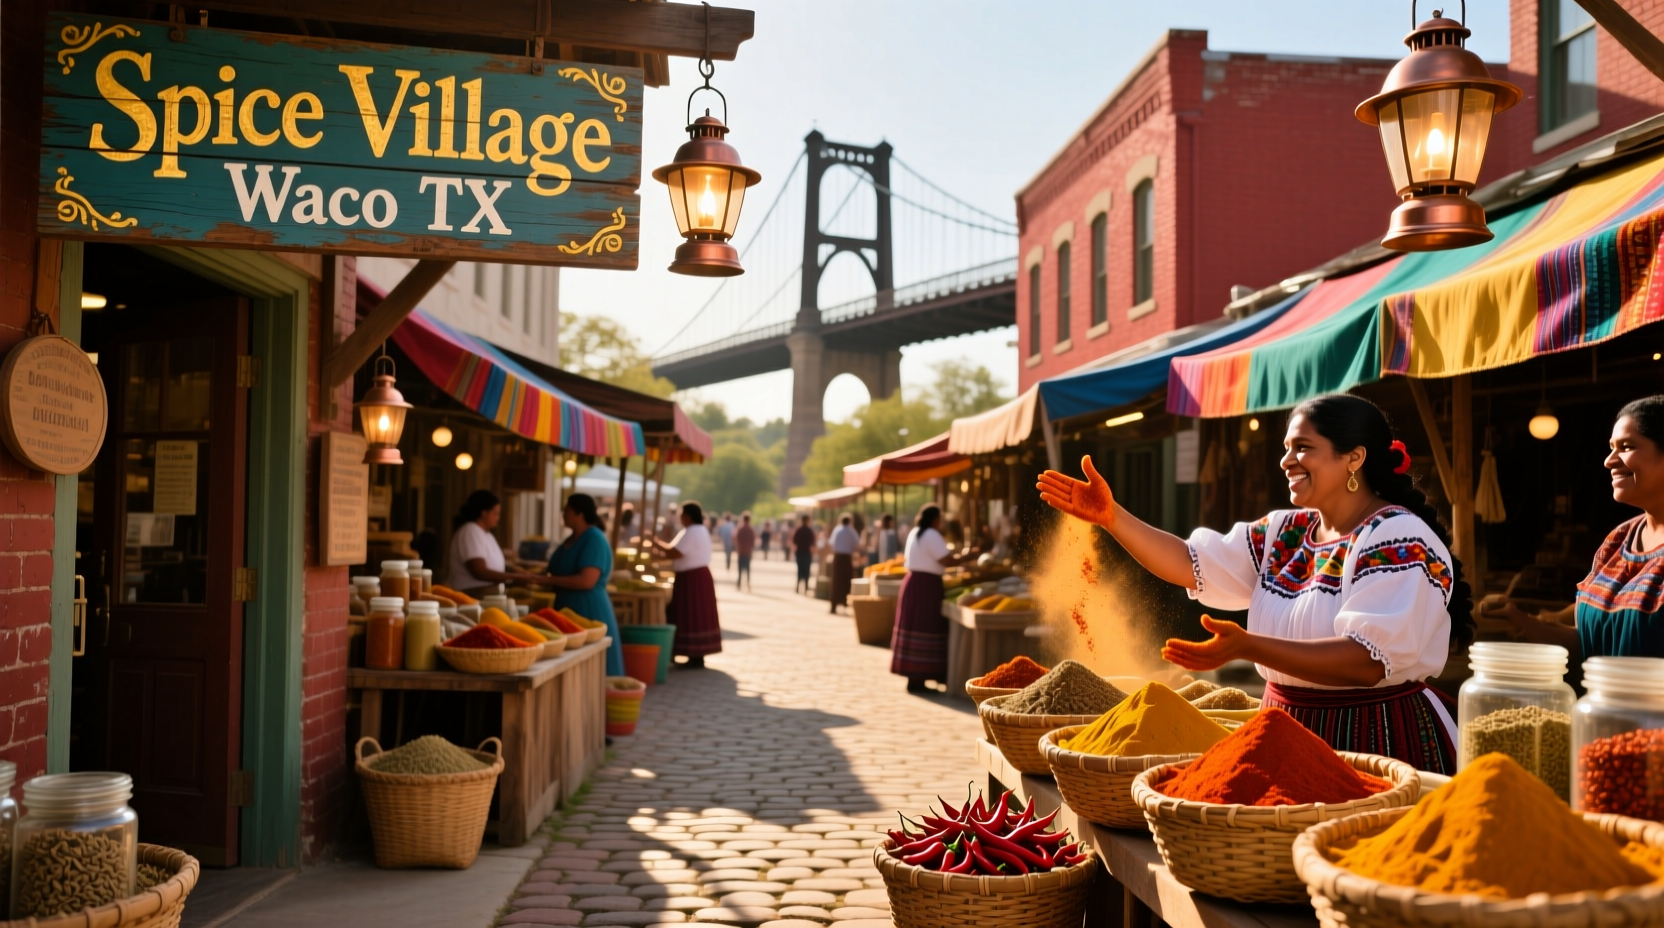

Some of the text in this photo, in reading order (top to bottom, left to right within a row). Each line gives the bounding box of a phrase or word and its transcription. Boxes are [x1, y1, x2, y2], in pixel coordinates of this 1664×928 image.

[89, 51, 612, 197] Spice Village
[224, 163, 513, 236] Waco TX
